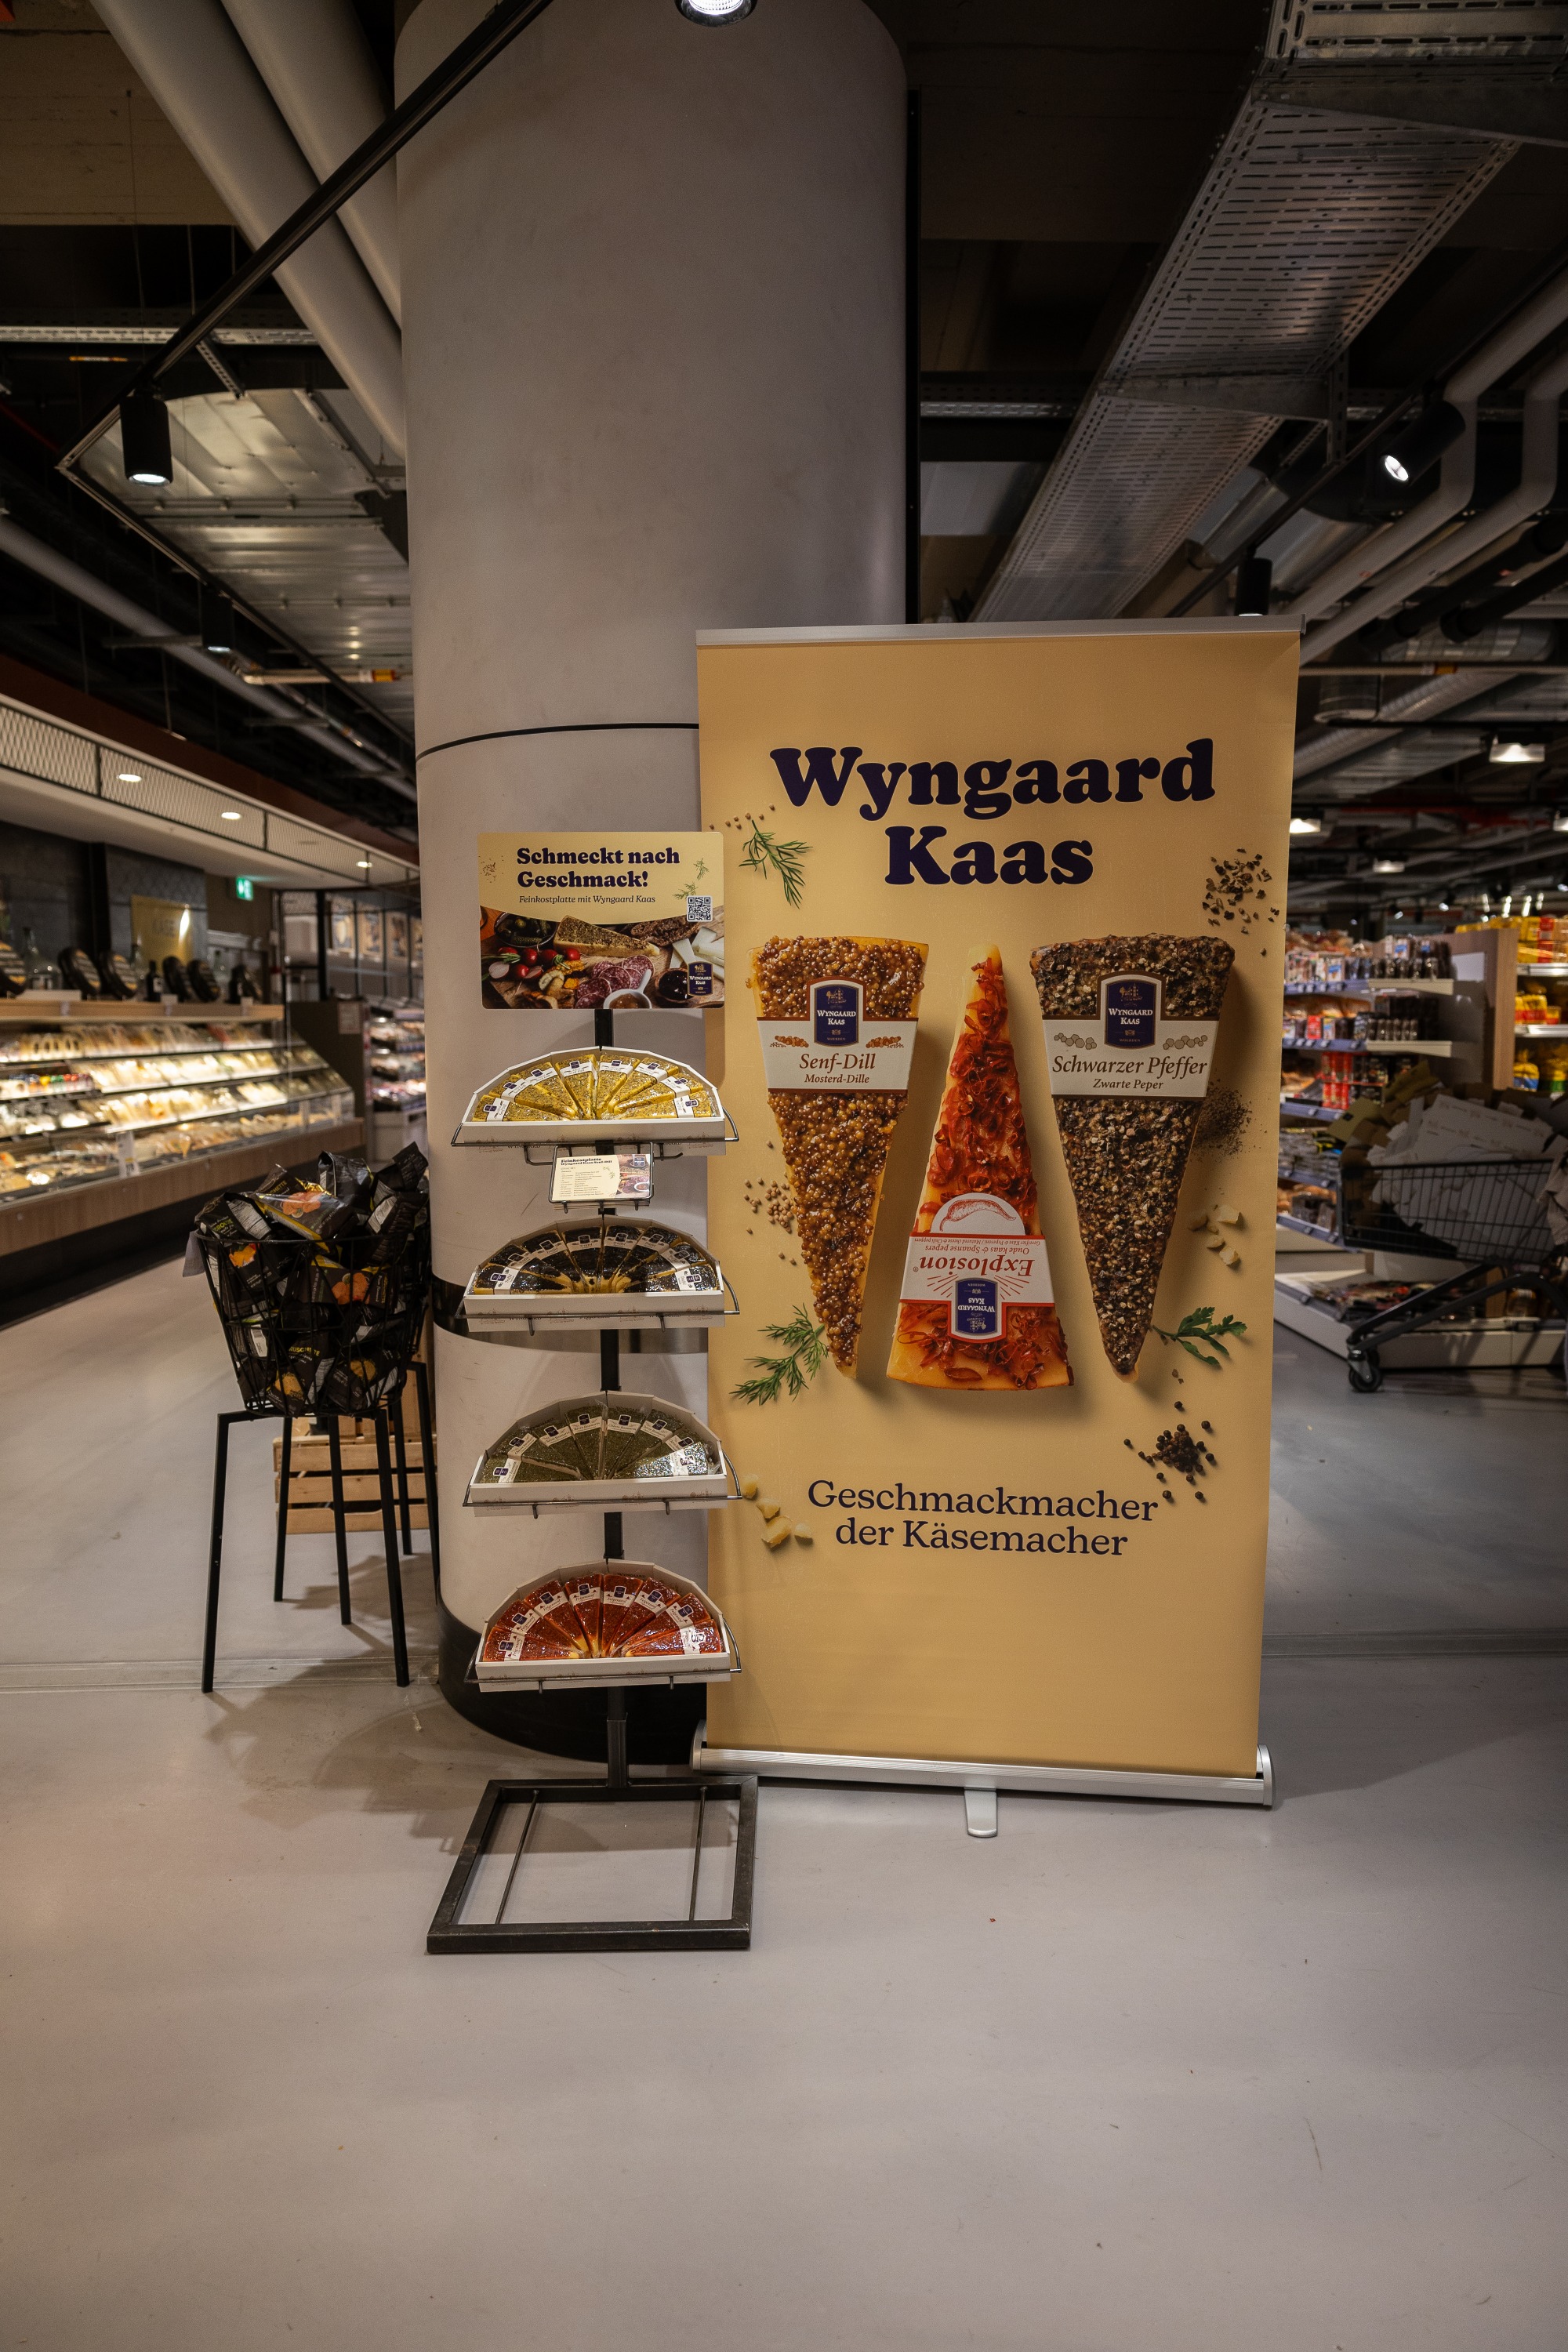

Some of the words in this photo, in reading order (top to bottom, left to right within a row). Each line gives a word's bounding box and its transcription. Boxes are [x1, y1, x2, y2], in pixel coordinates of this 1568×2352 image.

[769, 738, 1216, 821] Wyngaard
[517, 847, 623, 864] Schmeckt
[627, 847, 681, 864] nach
[884, 826, 1094, 885] Kaas
[517, 870, 648, 887] Geschmack!
[519, 895, 576, 905] Feinkostplatte
[593, 895, 634, 905] Wyngaard
[1108, 1007, 1153, 1016] WYNGAARD
[799, 1053, 877, 1073] Senf-Dill
[1052, 1054, 1144, 1074] Schwarzer
[1146, 1056, 1207, 1079] Pfeffer
[804, 1074, 870, 1083] Mosterd-Dille
[1093, 1078, 1131, 1089] Zwarte
[1133, 1079, 1164, 1091] Peper
[951, 1246, 981, 1254] Spaanse
[990, 1246, 1007, 1254] kaas
[808, 1479, 1159, 1522] Geschmackmacher
[835, 1517, 894, 1546] der
[902, 1519, 1129, 1556] Käsemacher
